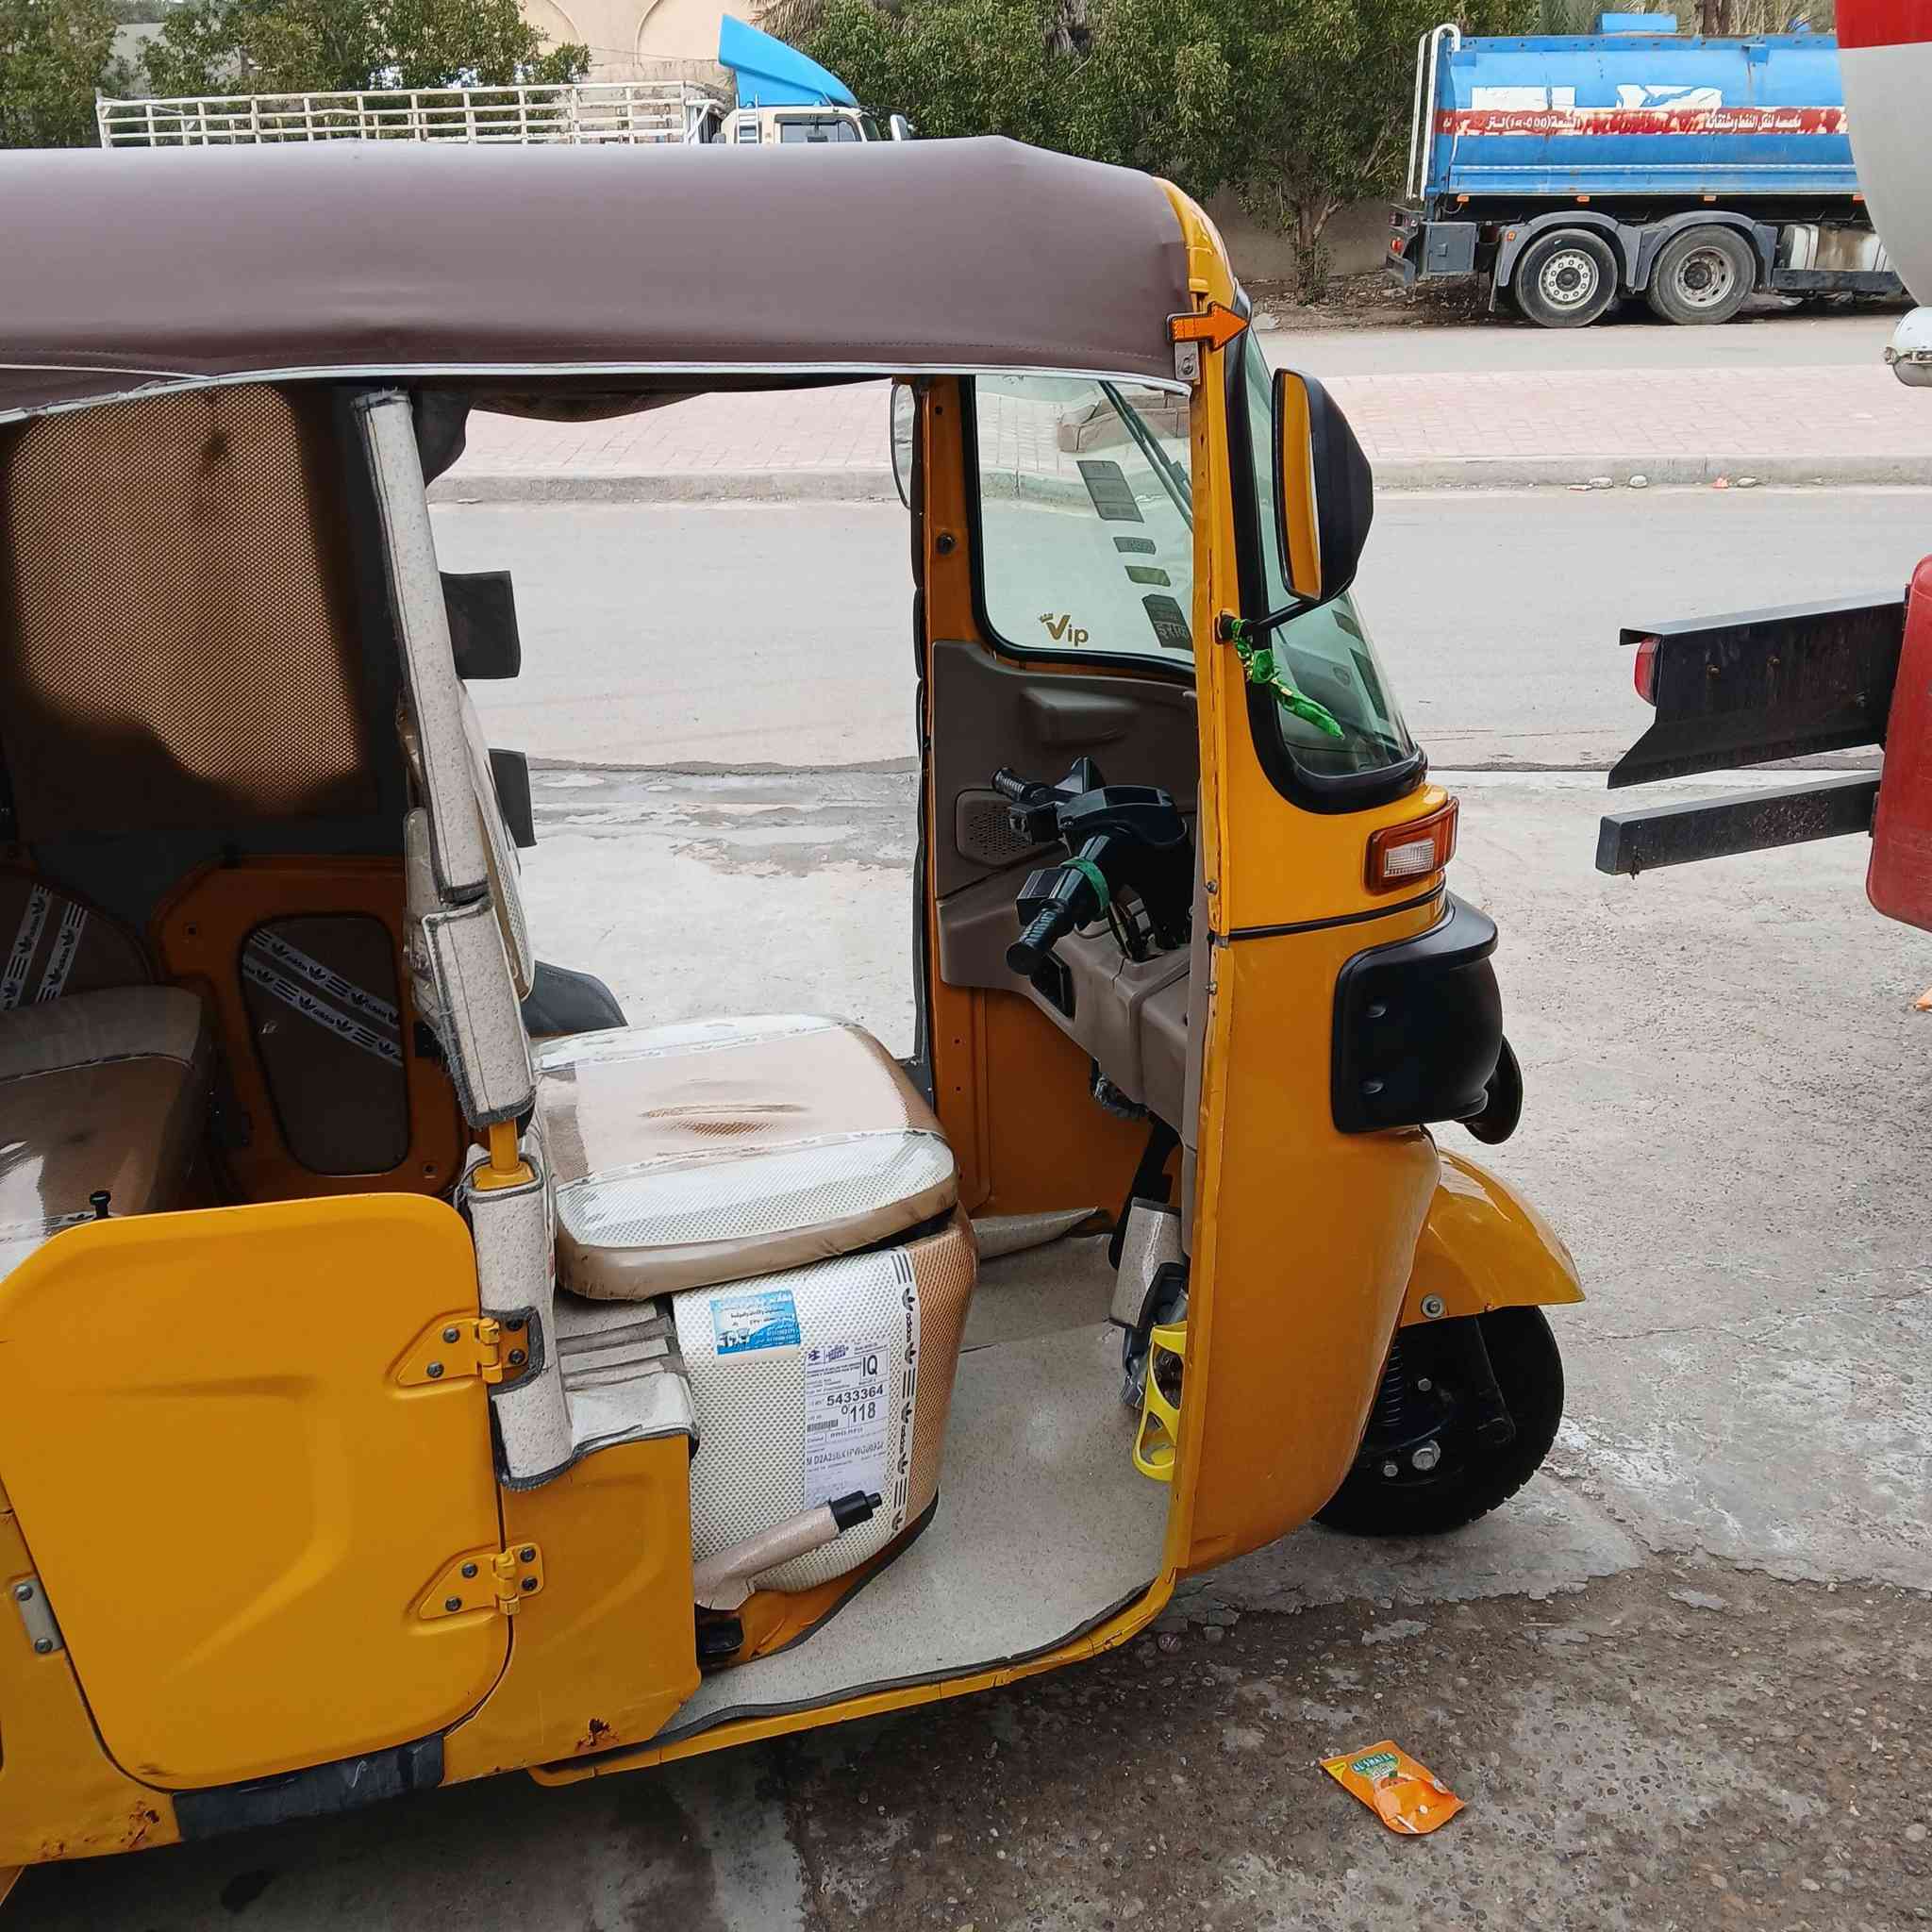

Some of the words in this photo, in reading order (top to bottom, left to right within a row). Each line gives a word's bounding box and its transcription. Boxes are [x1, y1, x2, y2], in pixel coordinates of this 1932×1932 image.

[1046, 614, 1089, 647] Vip
[862, 1355, 878, 1377] IQ
[826, 1383, 884, 1407] 5433364
